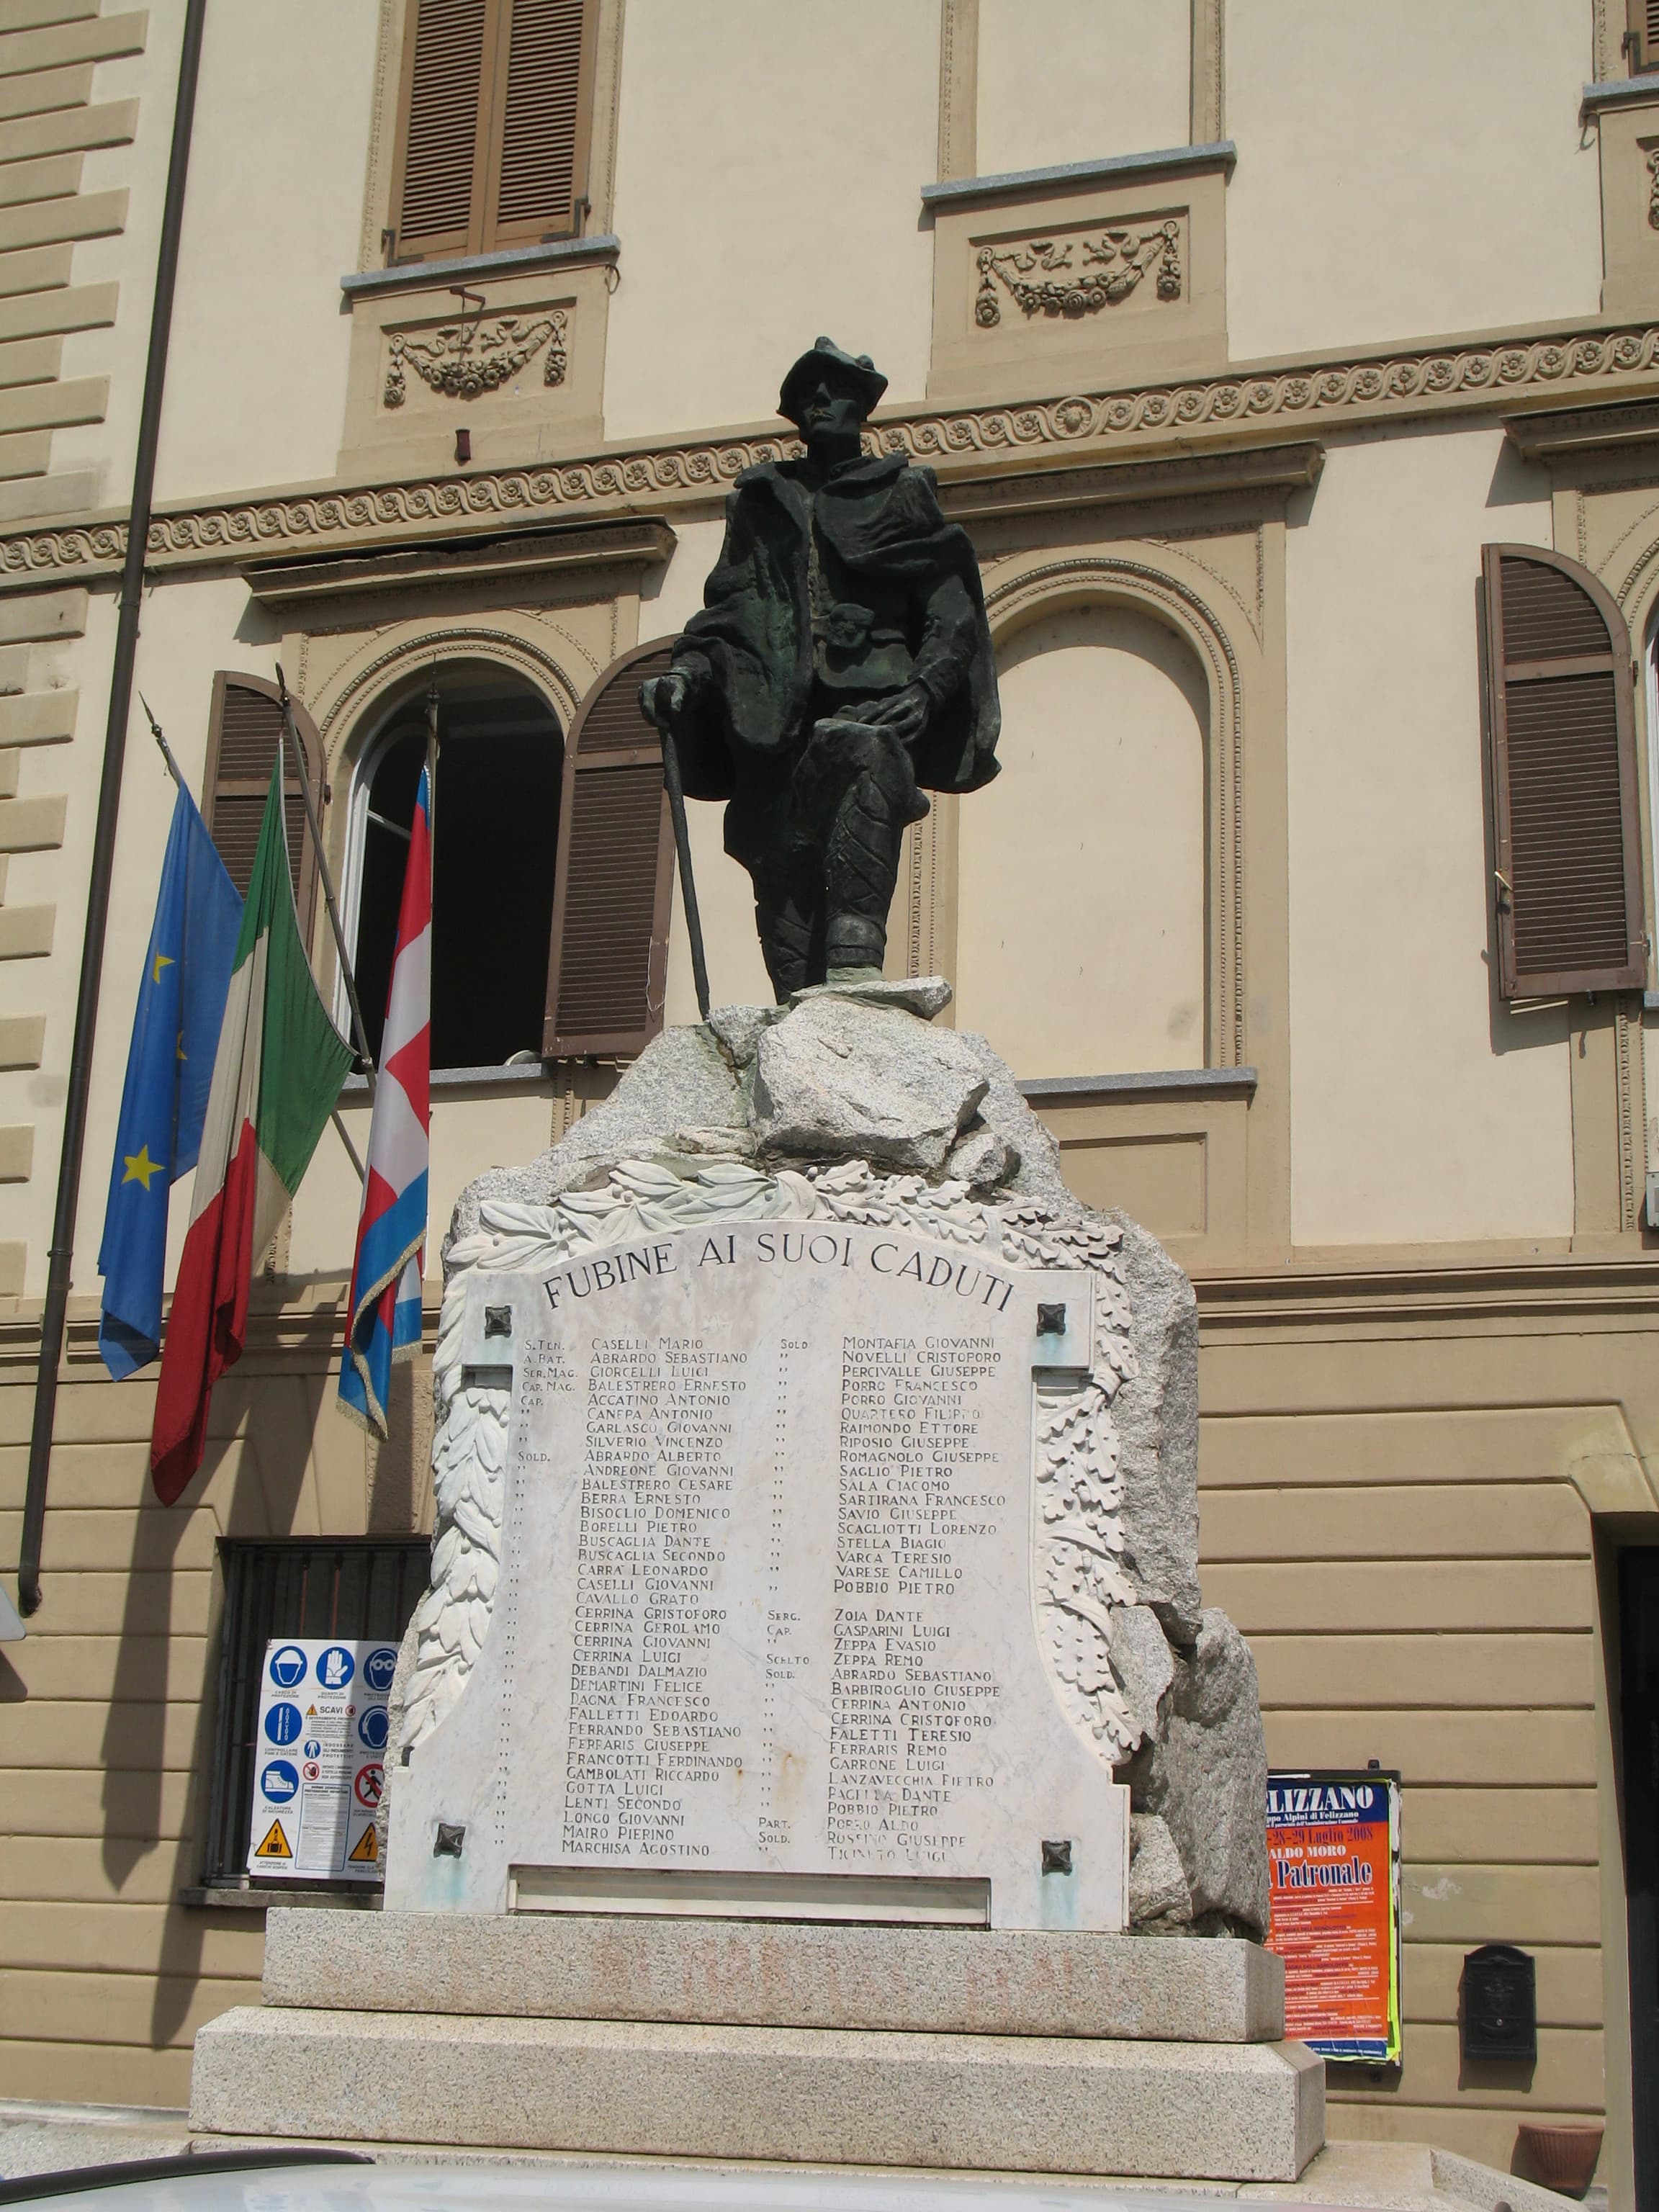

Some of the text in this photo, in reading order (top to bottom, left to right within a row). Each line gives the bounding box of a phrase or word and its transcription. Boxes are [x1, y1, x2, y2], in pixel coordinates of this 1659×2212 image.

[543, 1233, 1015, 1313] FUBINE AI SUOI CADUTI
[592, 1337, 703, 1349] CASELLI MARIO
[925, 1336, 994, 1349] GIOVANNI
[590, 1352, 747, 1364] ABRARDO SEBASTIANO
[843, 1351, 906, 1363] NOVELLI
[842, 1364, 995, 1377] PERCIVALLE GIUSEPPE
[588, 1379, 746, 1391] BALESTRERO ERNESTO
[588, 1393, 657, 1406] ACCATINO
[665, 1393, 729, 1406] ANTONIO
[842, 1393, 961, 1406] PORRO GIOVANNI
[649, 1408, 712, 1419] ANTONIO
[587, 1421, 731, 1433] GARLASCO GIOVANNI
[840, 1421, 978, 1434] RAIMONDO ETTORE
[586, 1436, 722, 1447] SILVERIO VINCENZO
[840, 1436, 968, 1448] RIPOSIO GIUSEPPE
[585, 1449, 649, 1462] ABRARDO
[657, 1449, 721, 1462] ALBERTO
[840, 1450, 999, 1462] ROMAGNOLO GIUSEPPE
[584, 1464, 732, 1476] ANDREONE GIOVANNI
[900, 1465, 952, 1477] PIETRO
[582, 1478, 732, 1491] BALESTRERO CESARE
[840, 1478, 877, 1491] SALA
[581, 1492, 700, 1505] BERRA ERNESTO
[840, 1493, 1005, 1506] SARTIRANA FRANCESCO
[655, 1506, 729, 1519] DOMENICO
[838, 1507, 956, 1520] SAVIO GIUSEPPE
[580, 1520, 696, 1532] BORELLI PIETRO
[931, 1522, 996, 1535] LORENZO
[578, 1534, 710, 1547] BUSCAGLIA DANTE
[837, 1537, 890, 1549] STELLA
[578, 1549, 725, 1561] BUSCAGLIA SECONDO
[891, 1551, 951, 1564] TERESIO
[632, 1564, 708, 1576] LEONARDO
[836, 1565, 962, 1579] VARESE CAMILLO
[577, 1578, 713, 1591] CASELLI GIOVANNI
[834, 1579, 954, 1595] POBBIO PIETRO
[577, 1591, 698, 1604] CAVALLO GRATO
[575, 1606, 634, 1619] CERRINA
[835, 1609, 867, 1622] ZOIA
[876, 1609, 922, 1622] DANTE
[575, 1620, 632, 1632] CERRINA
[834, 1624, 902, 1636] GASPARINI
[913, 1624, 950, 1637] LUIGI
[572, 1635, 710, 1648] CERRINA GIOVANNI
[835, 1637, 935, 1651] ZEPPA EVASIO
[573, 1649, 680, 1663] CERRINA LUIGI
[834, 1653, 876, 1665] ZEPPA
[886, 1653, 922, 1666] REMO
[572, 1663, 706, 1677] DEBANDI DALMAZIO
[830, 1668, 895, 1681] ABRARDO
[906, 1668, 994, 1681] SEBASTIANO
[571, 1677, 702, 1692] DEMARTINI FELICE
[935, 1684, 999, 1697] GIUSEPPE
[628, 1694, 709, 1707] FRANCESCO
[899, 1699, 966, 1711] ANTONIO
[570, 1707, 718, 1722] FALLETTI EDOARDO
[832, 1712, 992, 1727] CERRINA CRISTOFORO
[569, 1722, 741, 1737] FERRANDO SEBASTIANO
[830, 1727, 971, 1742] FALETTI TERESIO
[644, 1739, 709, 1752] GIUSEPPE
[830, 1742, 946, 1755] FERRARIS REMO
[657, 1753, 742, 1768] FERDINANDO
[907, 1758, 944, 1771] LUIGI
[656, 1768, 719, 1781] RICCARDO
[829, 1772, 932, 1786] LANZAVECCHIA
[902, 1788, 950, 1803] DANTE
[1266, 1786, 1374, 1814] LIZZANO
[565, 1795, 682, 1810] LENTI SECONDO
[889, 1803, 938, 1816] PIETRO
[619, 1812, 684, 1826] GIOVANNI
[759, 1817, 790, 1828] PART.
[564, 1825, 673, 1840] MAIRO PIERINO
[759, 1833, 790, 1843] SOLD.
[1308, 1828, 1343, 1845] Luglio
[1347, 1826, 1372, 1841] 2008
[562, 1840, 709, 1856] MARCHISA AGOSTINO
[1269, 1845, 1346, 1858] ALDO MORO
[1277, 1856, 1372, 1889] Patronale
